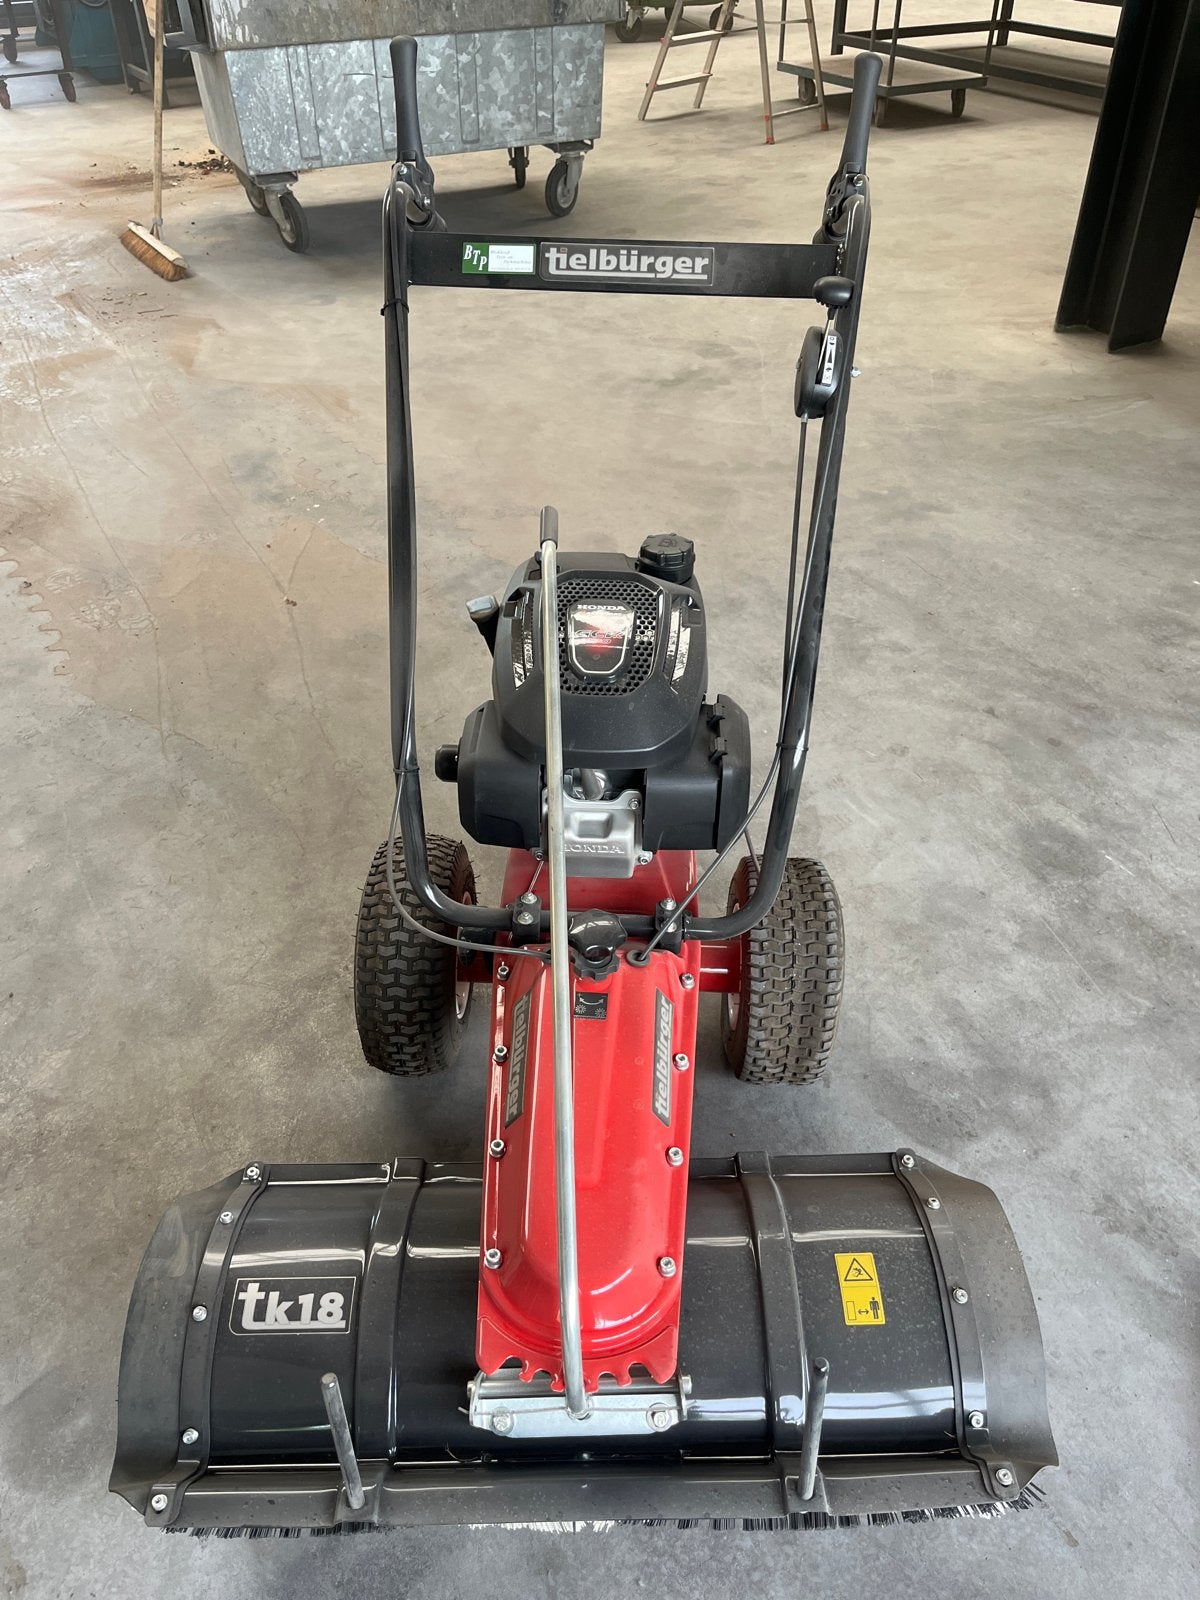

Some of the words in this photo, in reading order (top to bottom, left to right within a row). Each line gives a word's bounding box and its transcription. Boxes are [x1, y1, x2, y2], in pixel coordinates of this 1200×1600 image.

[463, 244, 487, 271] BTP
[545, 247, 709, 280] tielbürger
[506, 994, 528, 1122] tielbürger
[654, 995, 673, 1119] tielbürger
[238, 1283, 347, 1330] tk18
